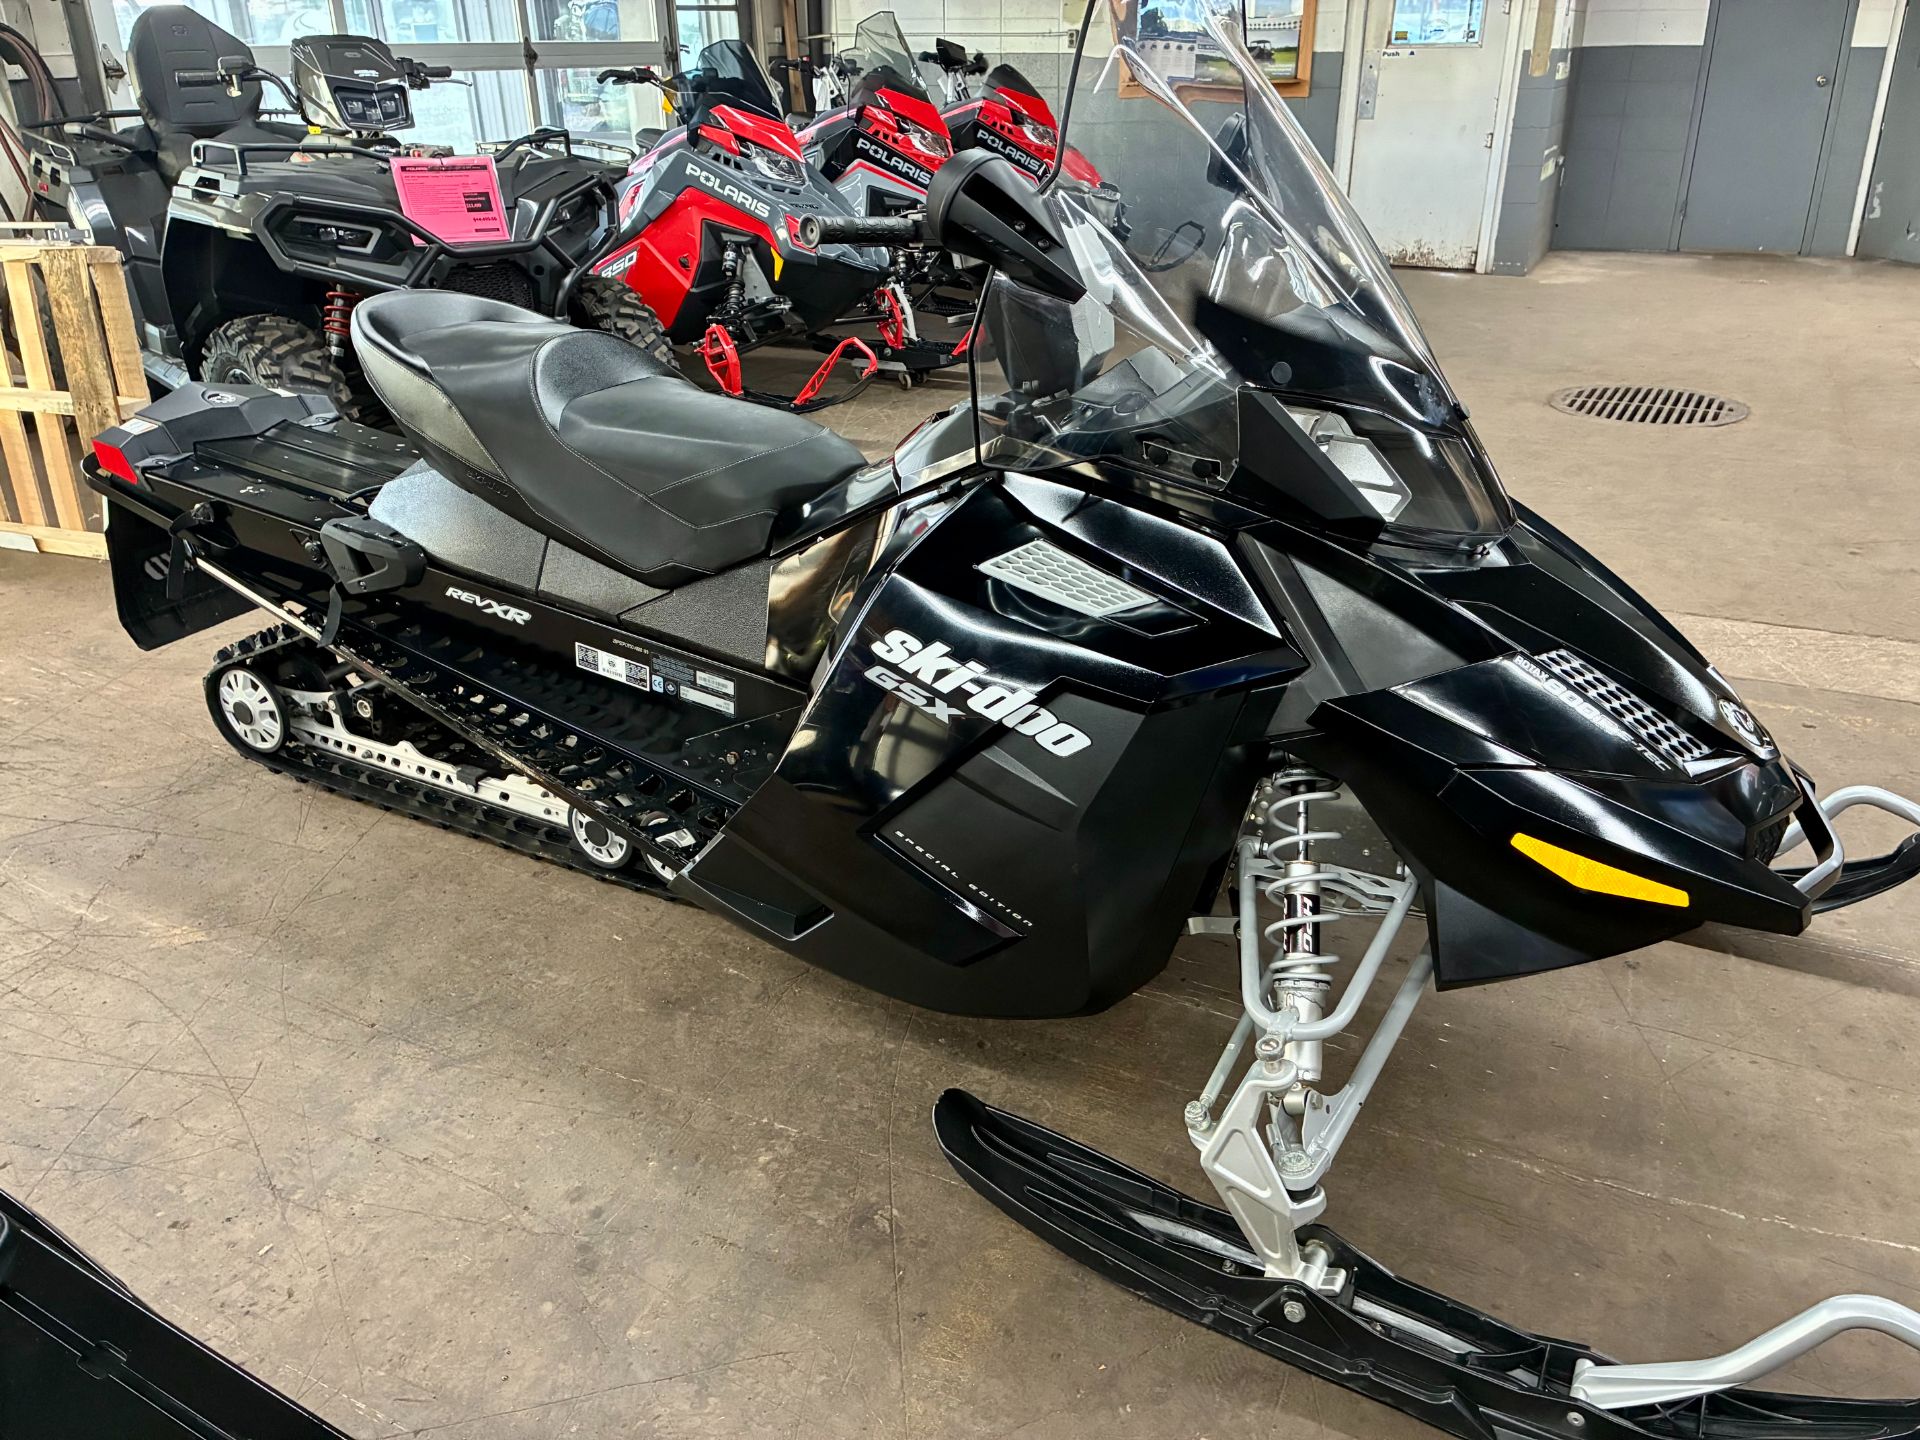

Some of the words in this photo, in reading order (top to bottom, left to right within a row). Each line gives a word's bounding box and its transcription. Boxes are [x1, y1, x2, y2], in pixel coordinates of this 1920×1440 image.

[856, 137, 932, 186] POLARIS
[975, 128, 1041, 172] POLARIS
[685, 162, 771, 218] POLARIS
[863, 665, 967, 725] GSX
[870, 630, 1093, 758] ski-doo
[1513, 654, 1550, 682] ROTAX
[894, 830, 959, 879] SPECIAL
[968, 883, 1033, 927] EDITION
